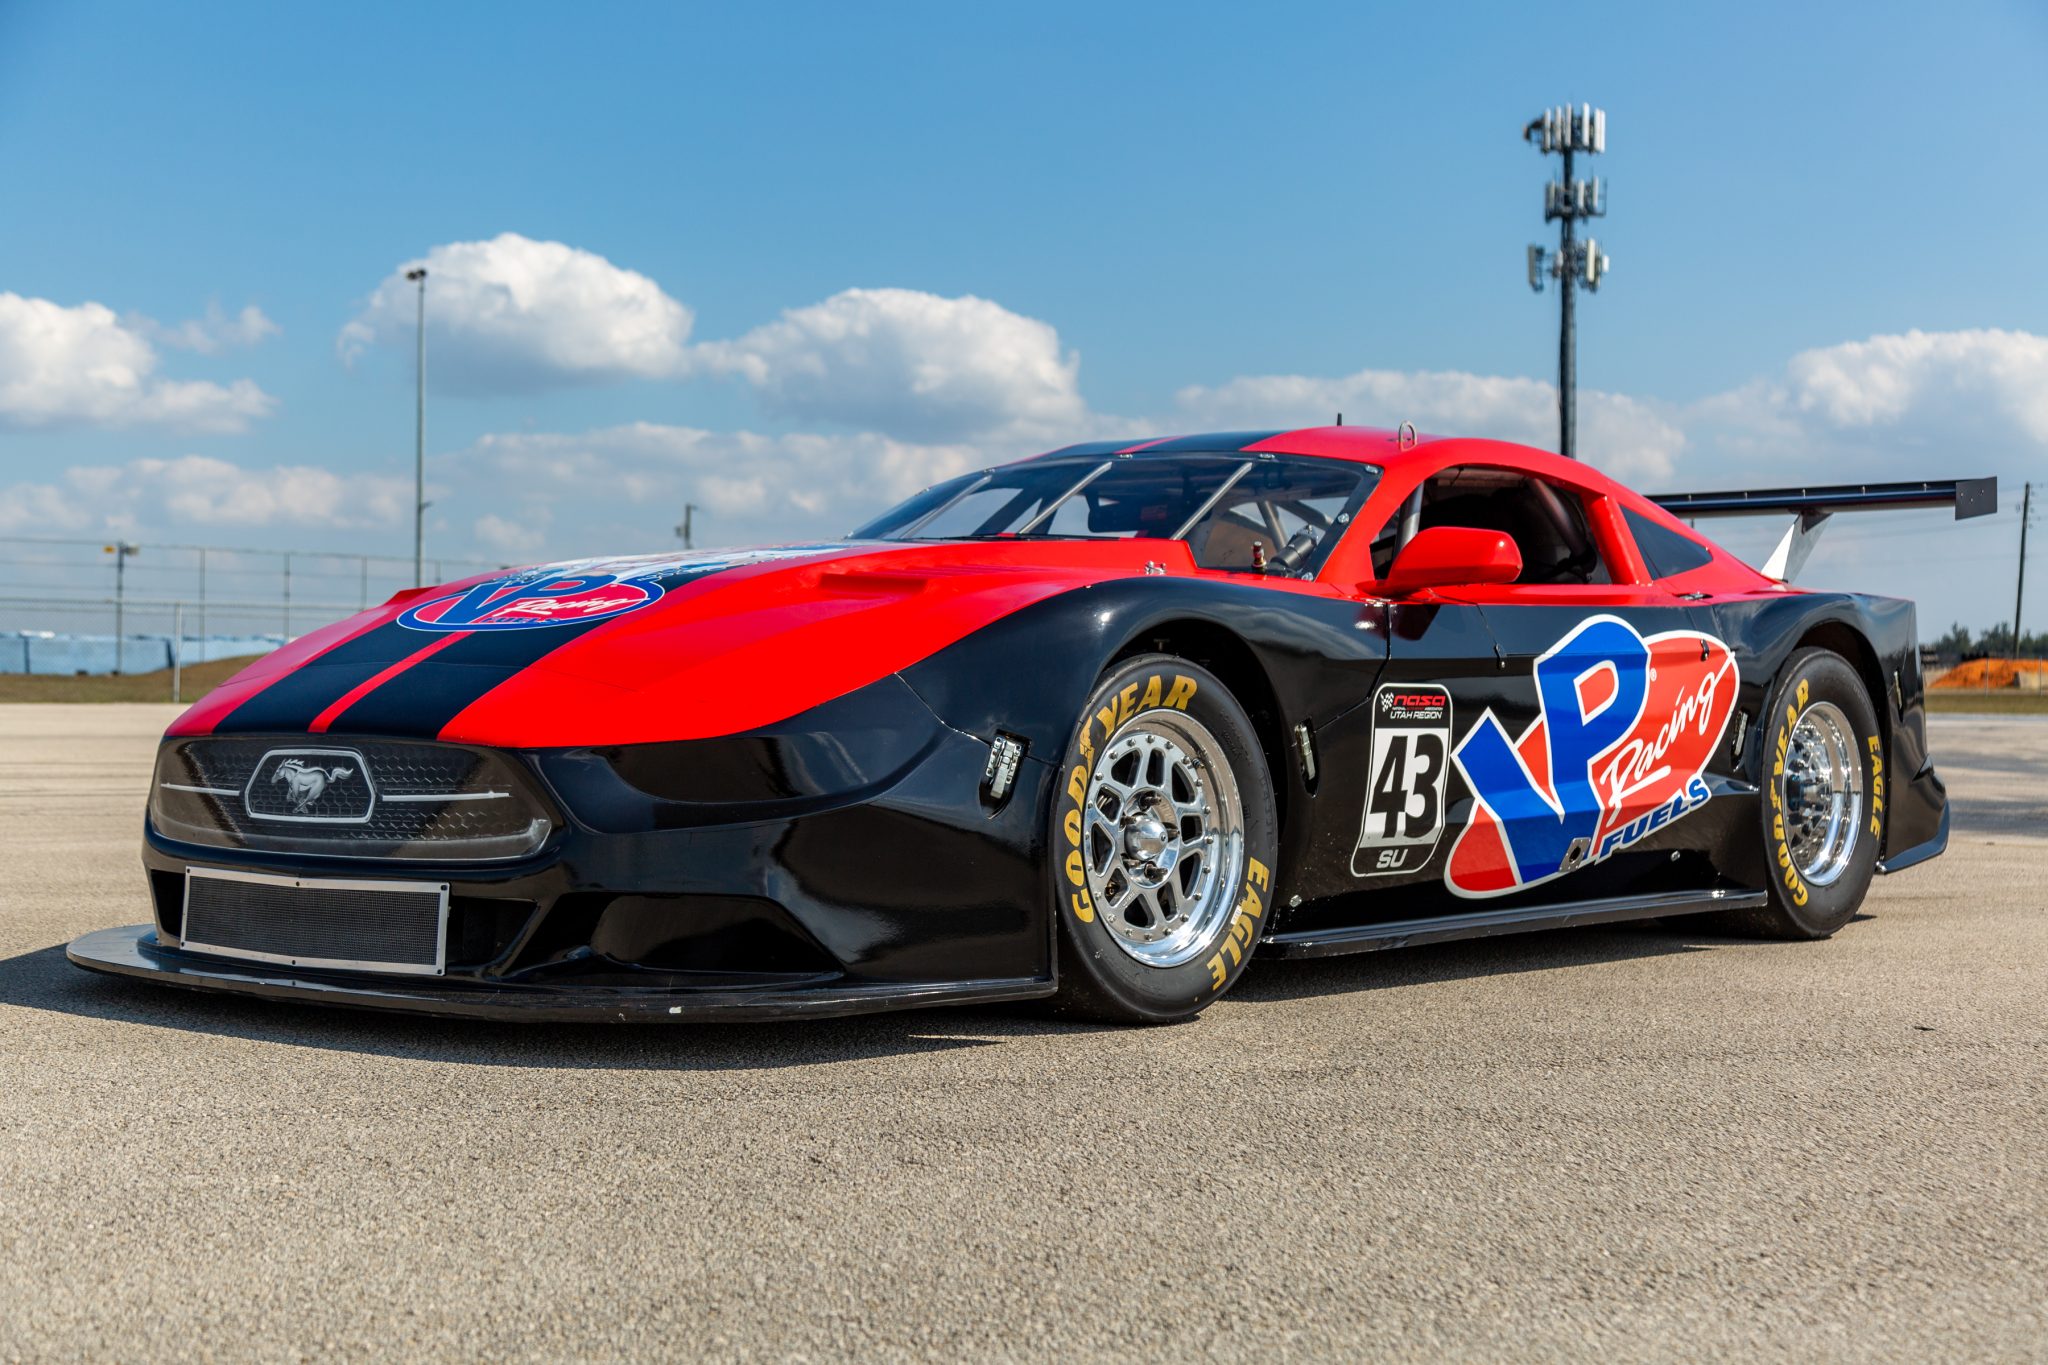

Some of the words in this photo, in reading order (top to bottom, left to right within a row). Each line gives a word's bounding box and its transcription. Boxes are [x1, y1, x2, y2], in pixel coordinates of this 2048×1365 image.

[434, 573, 618, 624] VP
[493, 597, 652, 618] Racing
[1390, 711, 1413, 719] UTAH
[1413, 711, 1442, 719] REGION
[1452, 616, 1651, 888] VP
[1600, 651, 1736, 828] Racing
[1370, 733, 1444, 839] 43
[1600, 777, 1709, 858] FUELS
[1867, 735, 1885, 841] EAGLE
[1376, 848, 1408, 869] SU
[1207, 857, 1270, 991] EAGLE
